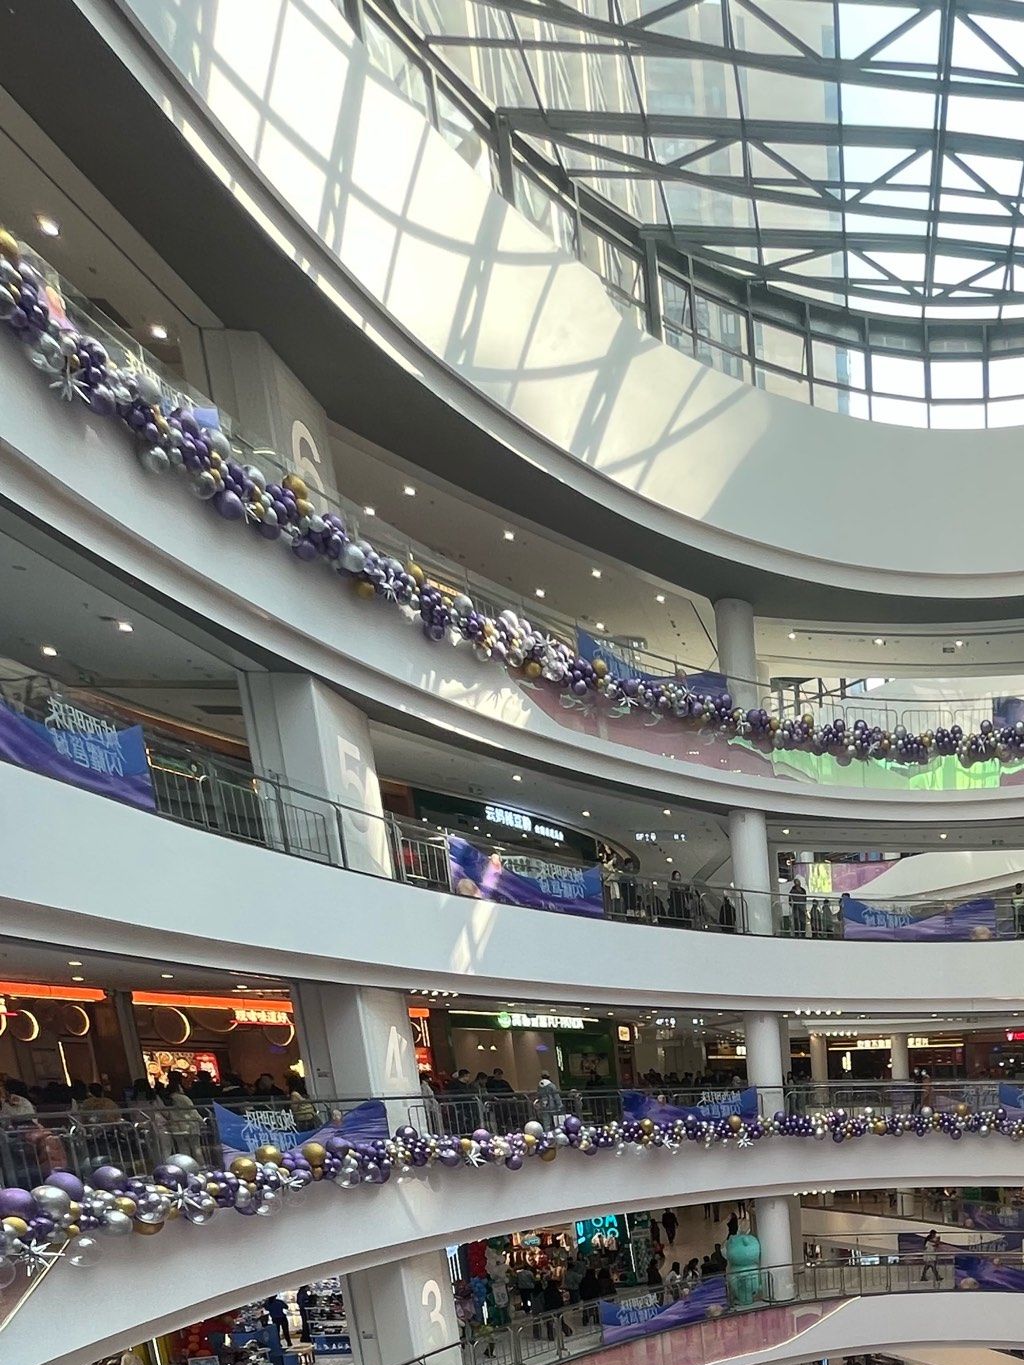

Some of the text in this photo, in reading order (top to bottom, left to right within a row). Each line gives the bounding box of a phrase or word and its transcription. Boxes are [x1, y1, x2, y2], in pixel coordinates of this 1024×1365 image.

[292, 420, 328, 513] 6
[337, 735, 370, 836] 5
[385, 1025, 409, 1084] 4
[421, 1280, 449, 1340] 3
